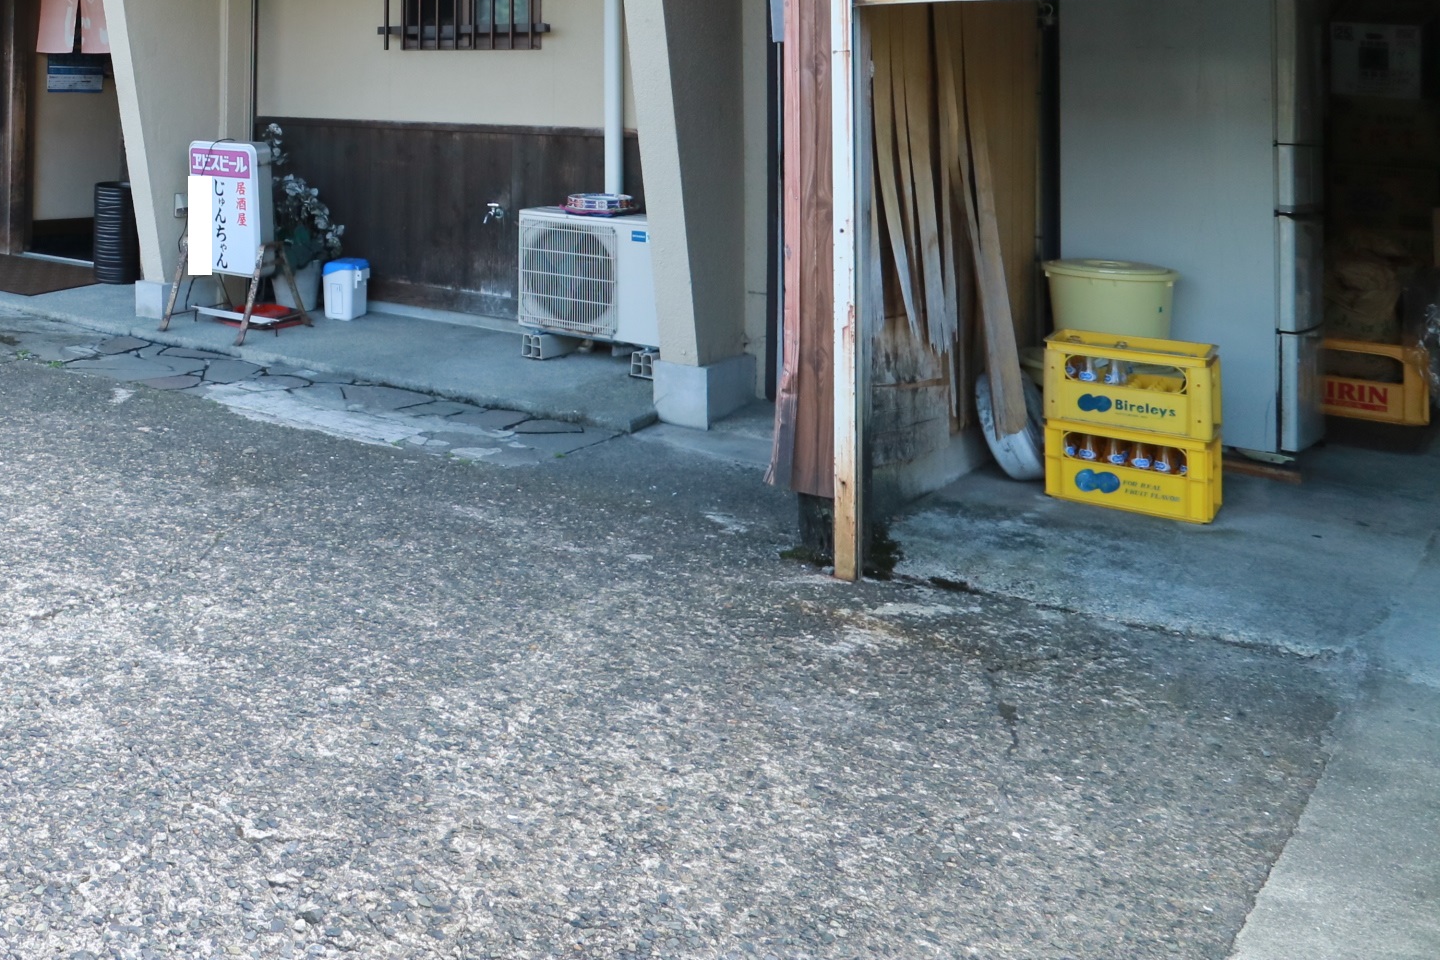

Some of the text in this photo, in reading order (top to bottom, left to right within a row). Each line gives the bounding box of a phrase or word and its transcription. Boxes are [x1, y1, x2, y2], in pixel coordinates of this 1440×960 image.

[214, 178, 229, 270] じゅんちゃん
[235, 181, 248, 227] 居酒屋
[1323, 380, 1389, 407] IRIN
